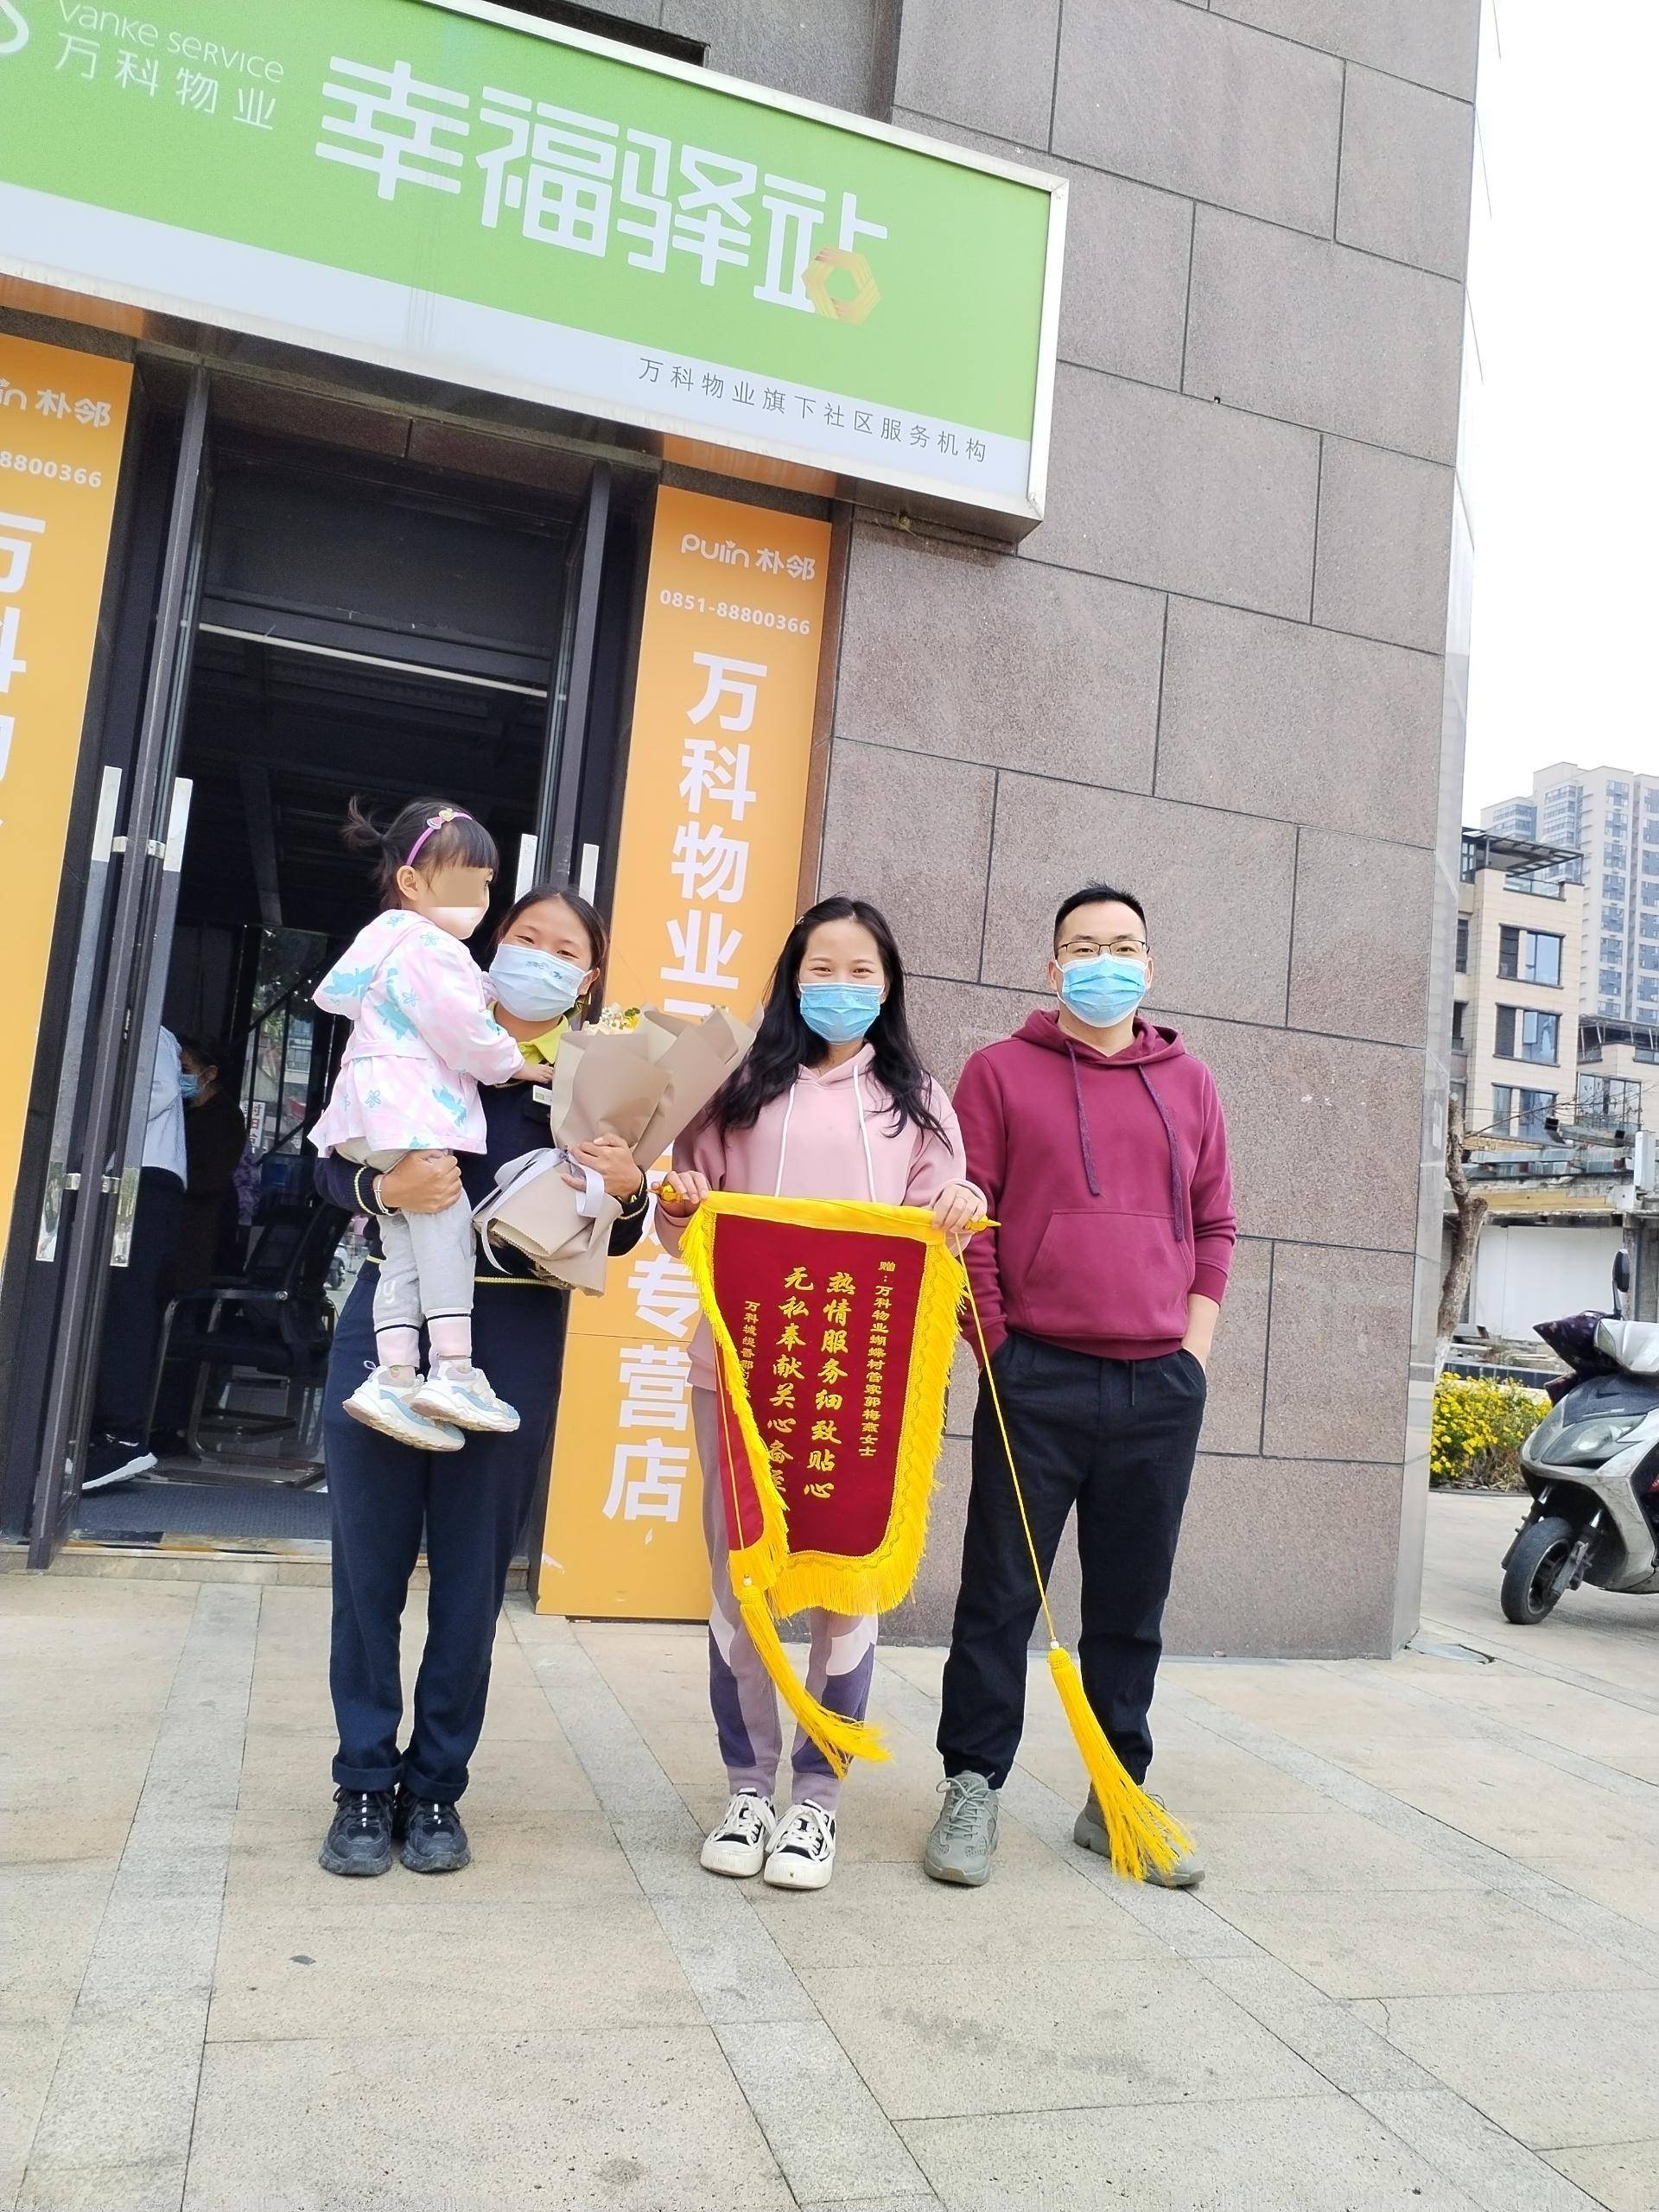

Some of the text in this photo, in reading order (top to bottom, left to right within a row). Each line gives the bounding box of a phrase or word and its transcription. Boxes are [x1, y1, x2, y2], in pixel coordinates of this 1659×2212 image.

[55, 32, 276, 130] 万科物业
[315, 56, 887, 321] 幸福驿站
[35, 389, 111, 427] 朴邻
[639, 357, 987, 463] 万科物业旗下社区服务机构
[659, 589, 810, 635] 0851-88800366
[755, 548, 816, 581] 朴邻
[803, 1271, 855, 1498] 热情服务细致贴心
